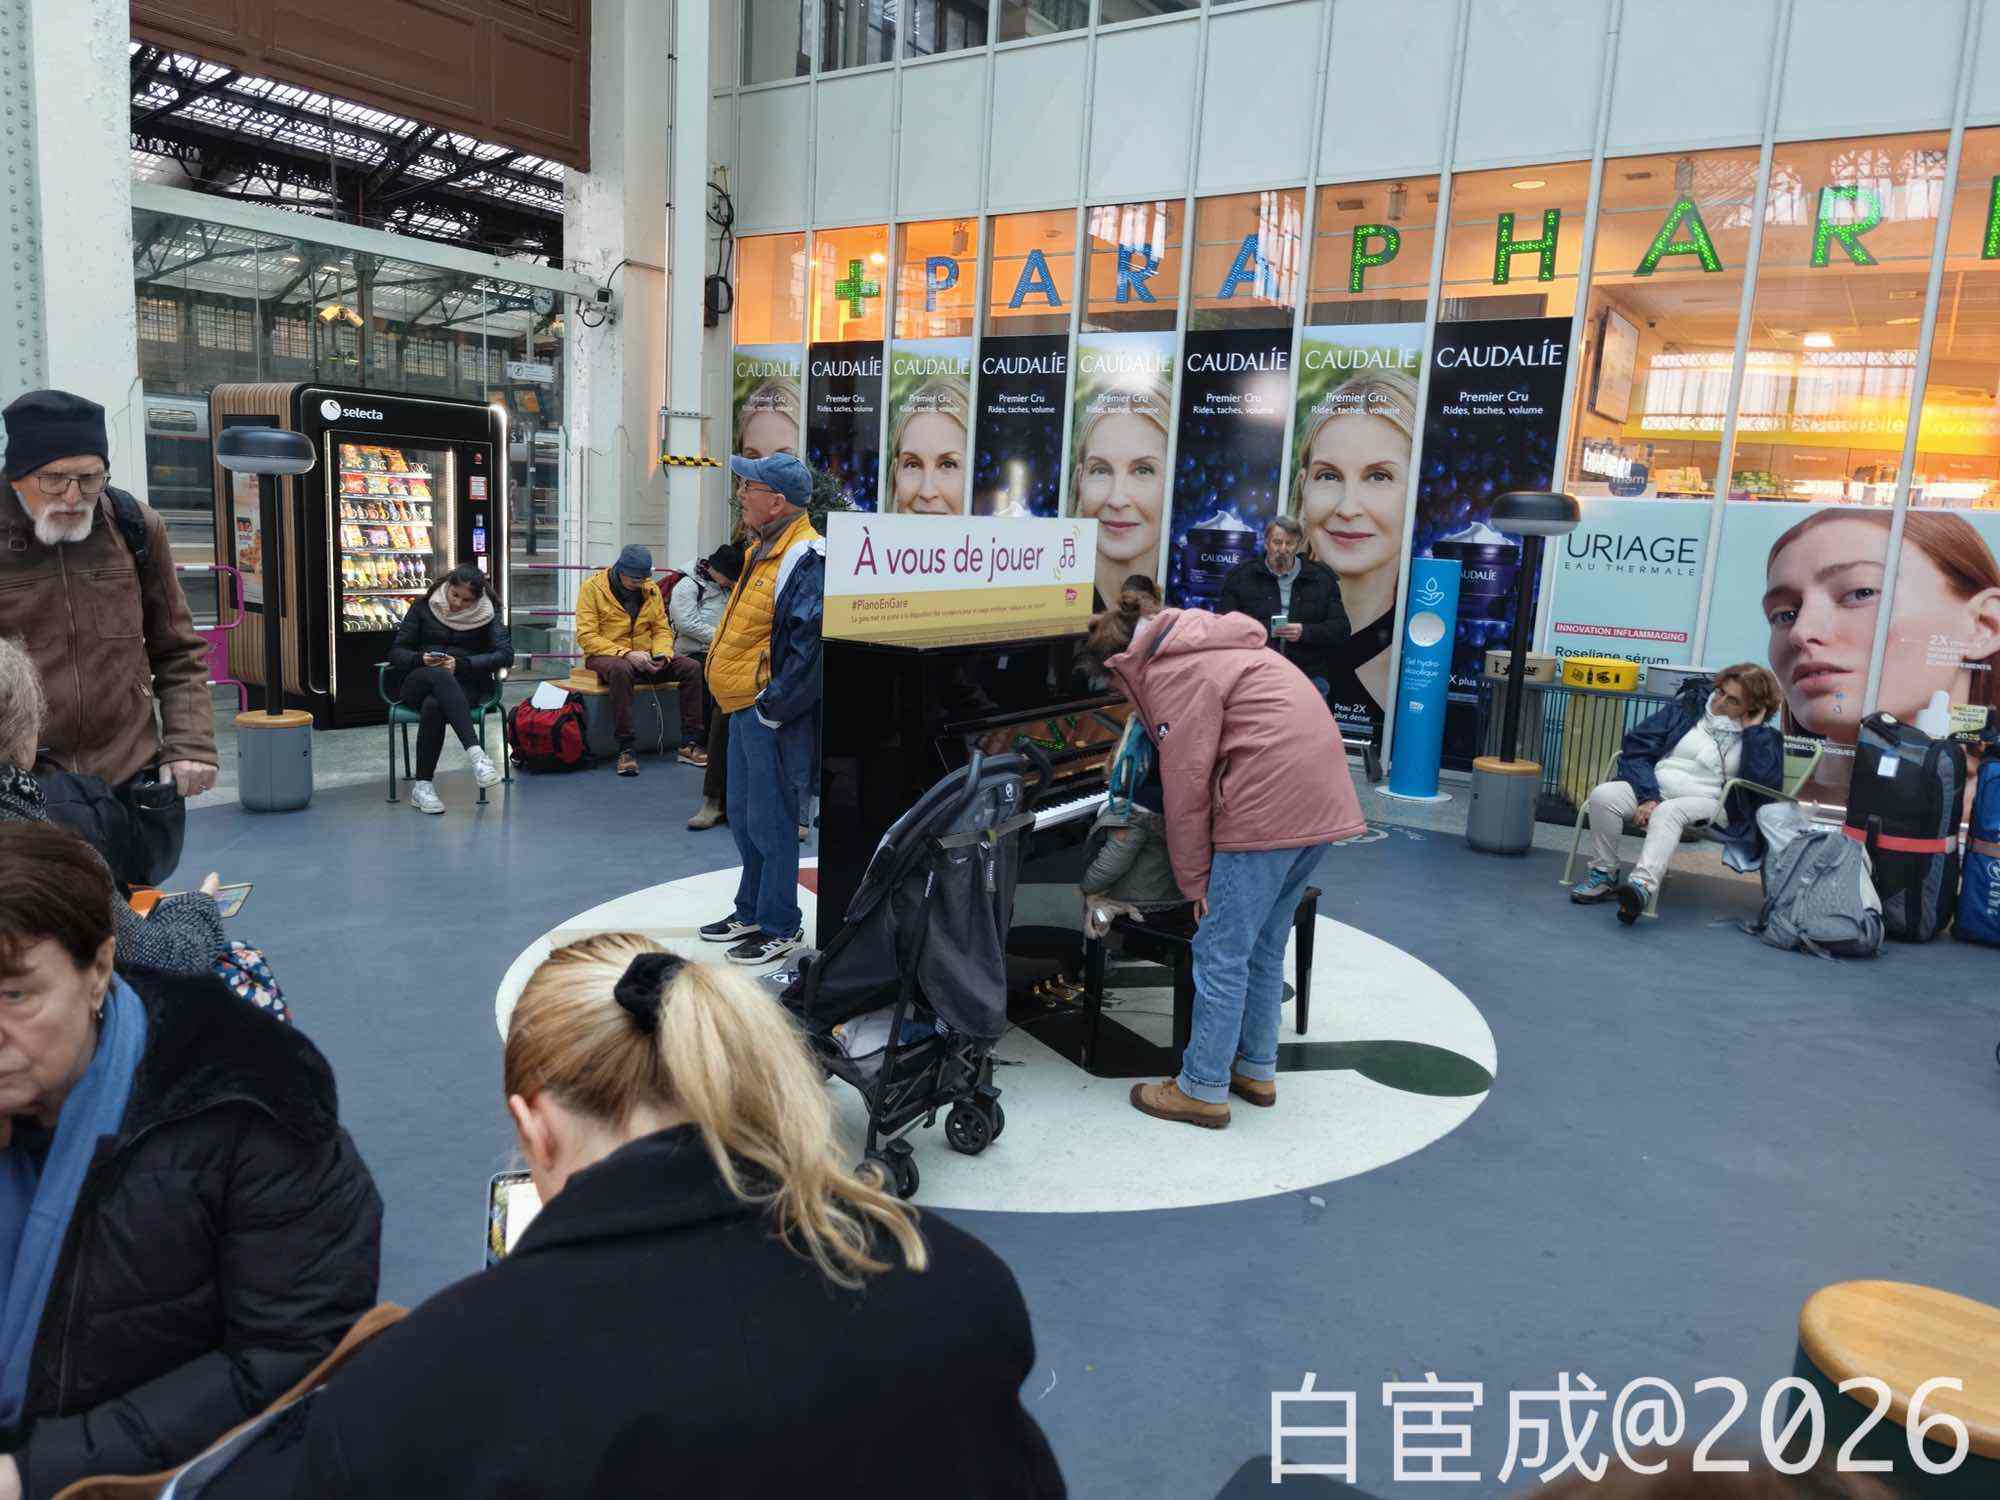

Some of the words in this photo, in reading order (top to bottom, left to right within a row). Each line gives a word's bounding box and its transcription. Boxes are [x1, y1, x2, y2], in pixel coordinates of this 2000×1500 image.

[925, 174, 2000, 313] PARAPHAR
[1187, 347, 1288, 372] CAUDALÍE
[1437, 339, 1563, 368] CAUDALÍE
[811, 356, 882, 377] CAUDALÍE
[981, 352, 1067, 375] CAUDALÍE
[825, 394, 851, 403] Premier
[853, 394, 865, 403] Cru
[998, 393, 1028, 403] Premier
[1030, 393, 1045, 403] Cru
[1206, 393, 1241, 404] Premier
[1244, 394, 1261, 404] Cru
[1326, 391, 1366, 403] Premier
[1367, 391, 1388, 402] Cru
[1459, 391, 1504, 403] Premier
[1507, 391, 1529, 402] Cru
[342, 407, 384, 420] selecta
[987, 405, 1006, 414] Rides,
[1031, 406, 1055, 414] volume
[1192, 405, 1215, 415] Rides,
[1217, 406, 1243, 416] taches,
[1337, 406, 1365, 417] taches,
[1443, 403, 1470, 416] Rides,
[1473, 404, 1506, 416] taches,
[1508, 404, 1543, 415] volume
[853, 526, 878, 576] À
[885, 548, 946, 575] vous
[953, 535, 983, 573] de
[987, 537, 1044, 582] jouer
[1567, 532, 1699, 564] URIAGE
[1564, 561, 1597, 571] EAU
[1605, 563, 1696, 577] THERMALE
[1556, 623, 1612, 636] INNOVATION
[1613, 628, 1686, 642] INFLAMMAGING
[1625, 652, 1670, 665] sérum
[1334, 703, 1351, 712] Peau
[1353, 703, 1367, 714] 2X
